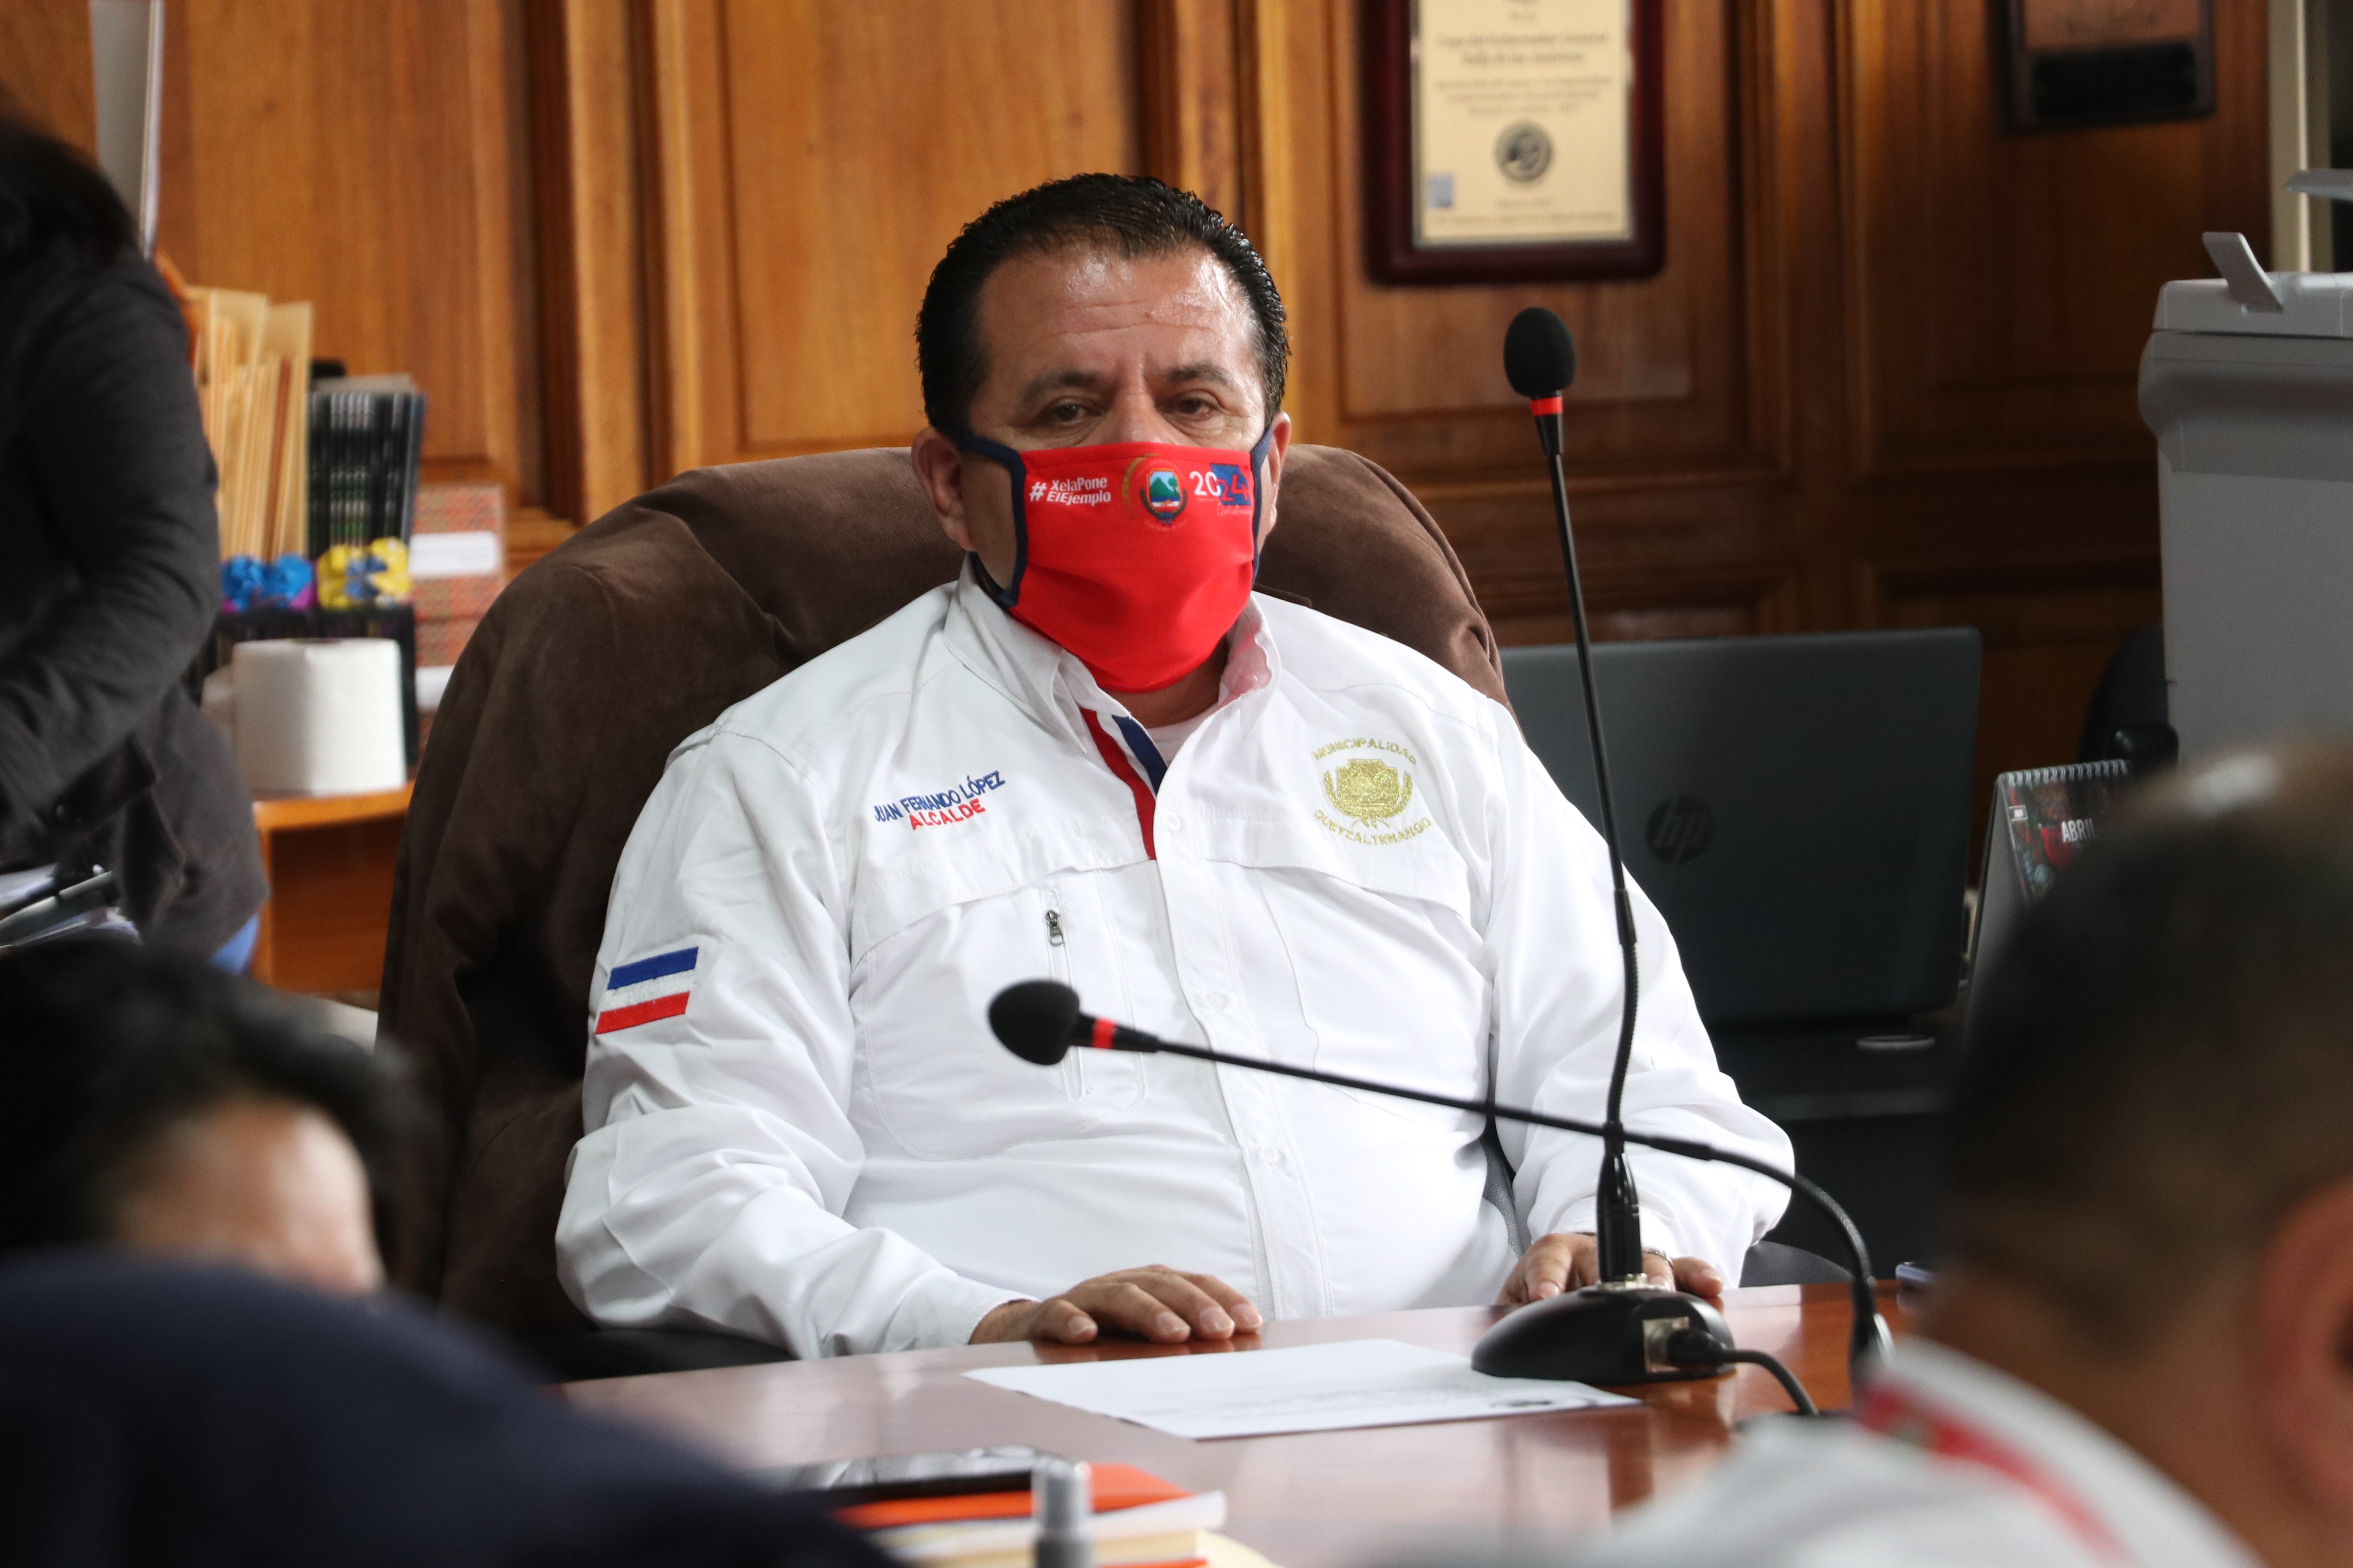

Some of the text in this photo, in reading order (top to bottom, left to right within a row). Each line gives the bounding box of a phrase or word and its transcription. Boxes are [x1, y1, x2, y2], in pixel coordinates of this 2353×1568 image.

[1046, 489, 1111, 507] ElEjemplo
[1189, 470, 1249, 501] 2024
[1312, 737, 1416, 764] MUNICIPALIDAD
[874, 770, 1005, 822] JUAN FERNANDO LÓPEZ
[909, 798, 986, 830] ALCALDE
[1314, 810, 1431, 846] QUETZALTENANGO
